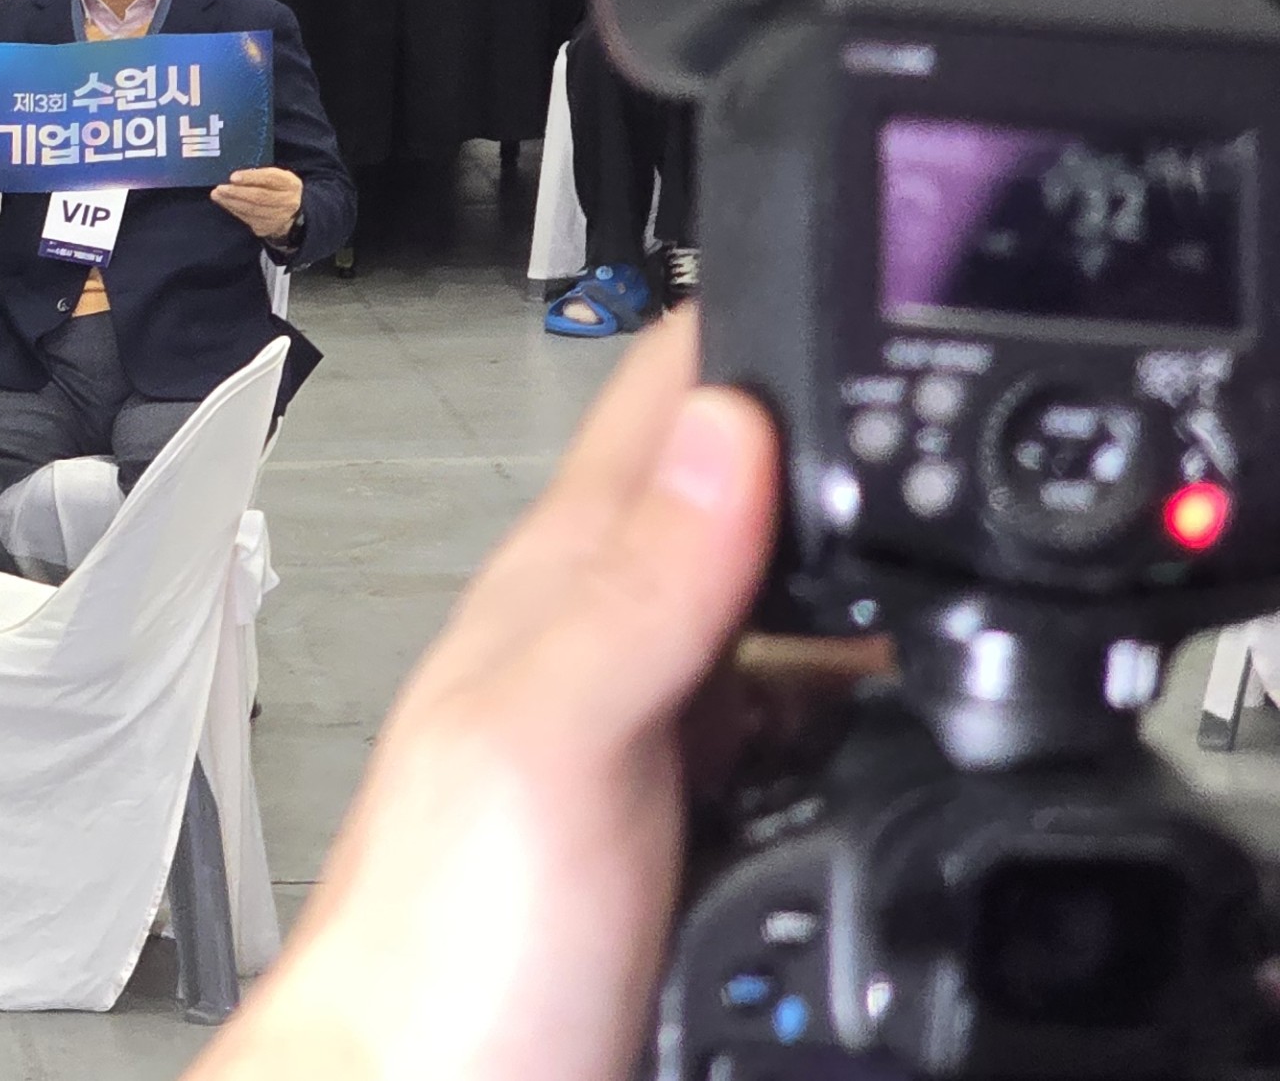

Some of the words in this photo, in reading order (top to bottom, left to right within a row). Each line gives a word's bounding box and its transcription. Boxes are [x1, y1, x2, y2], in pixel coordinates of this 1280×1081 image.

[13, 92, 66, 115] 제3회
[73, 64, 201, 114] 수원시
[180, 114, 224, 159] 날
[62, 199, 111, 228] VIP
